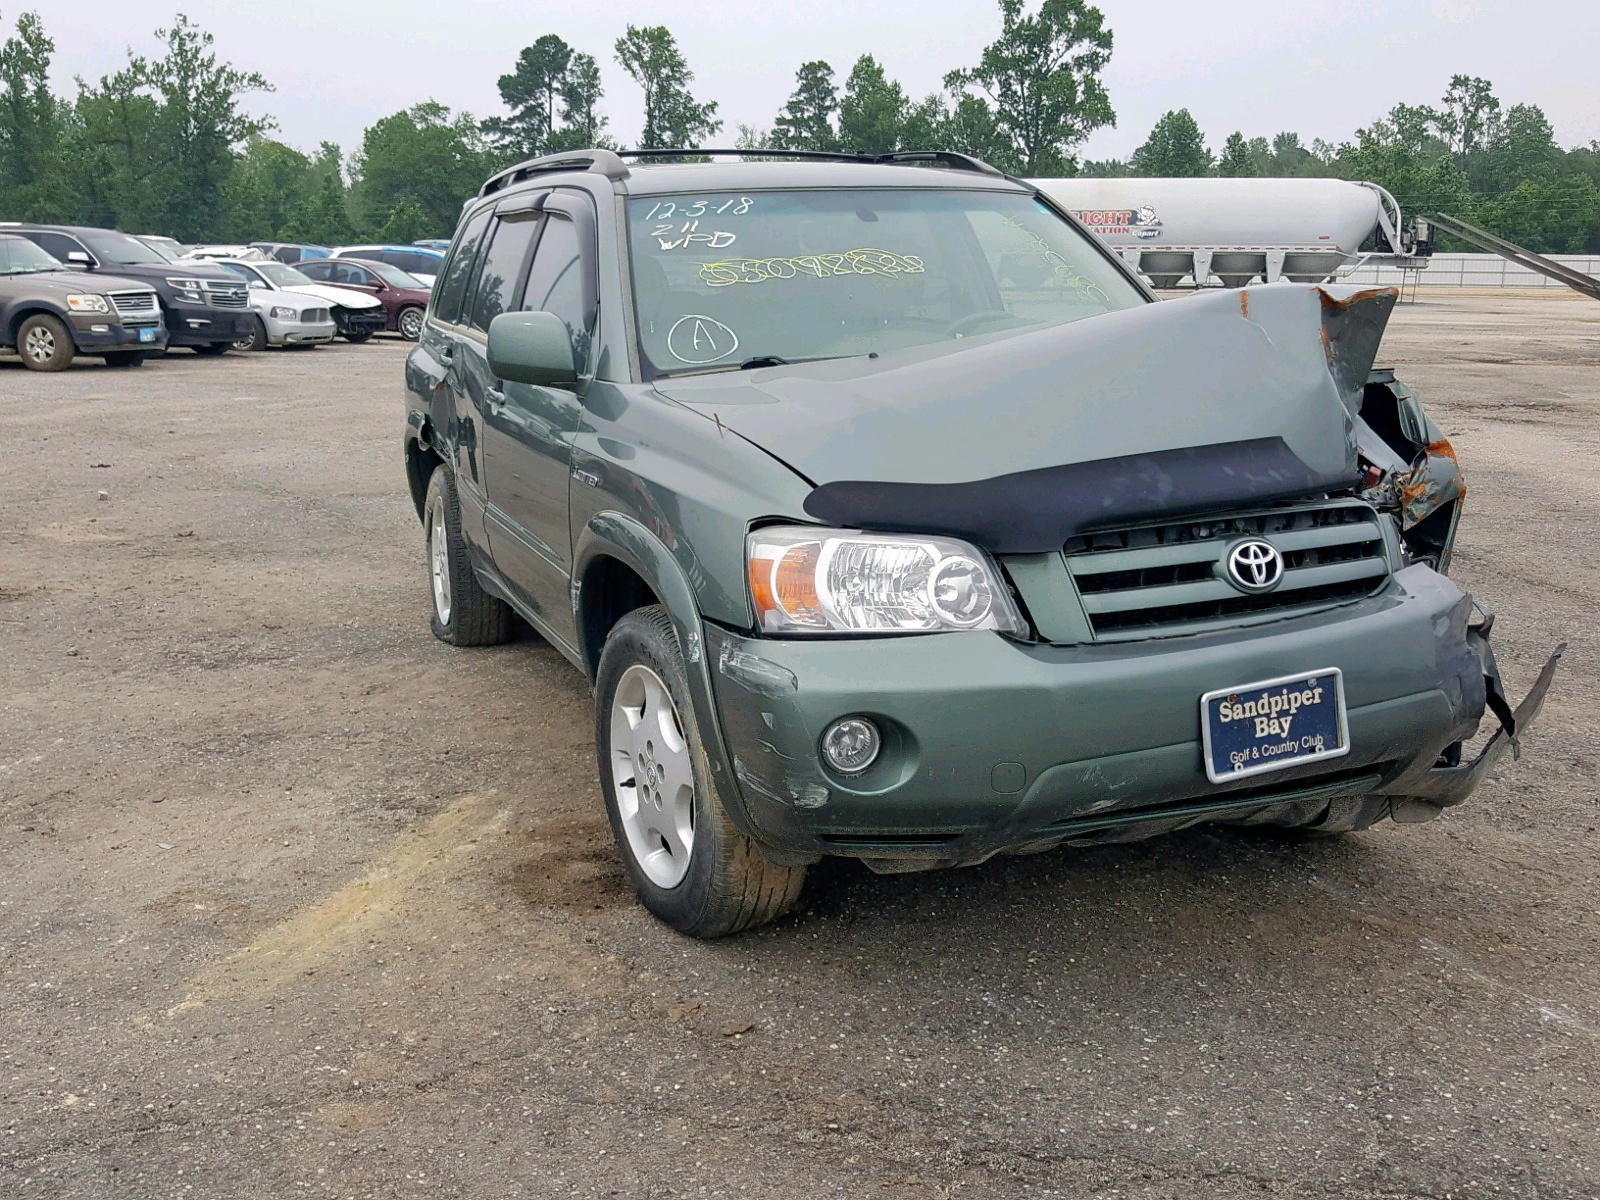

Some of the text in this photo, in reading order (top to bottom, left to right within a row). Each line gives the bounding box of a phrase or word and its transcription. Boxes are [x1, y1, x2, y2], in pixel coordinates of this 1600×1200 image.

[645, 197, 754, 221] 12-3-18
[693, 319, 717, 351] A
[1219, 687, 1323, 723] Sandpiper
[1254, 715, 1293, 738] Bay
[1230, 733, 1324, 764] Golf & Country Club
